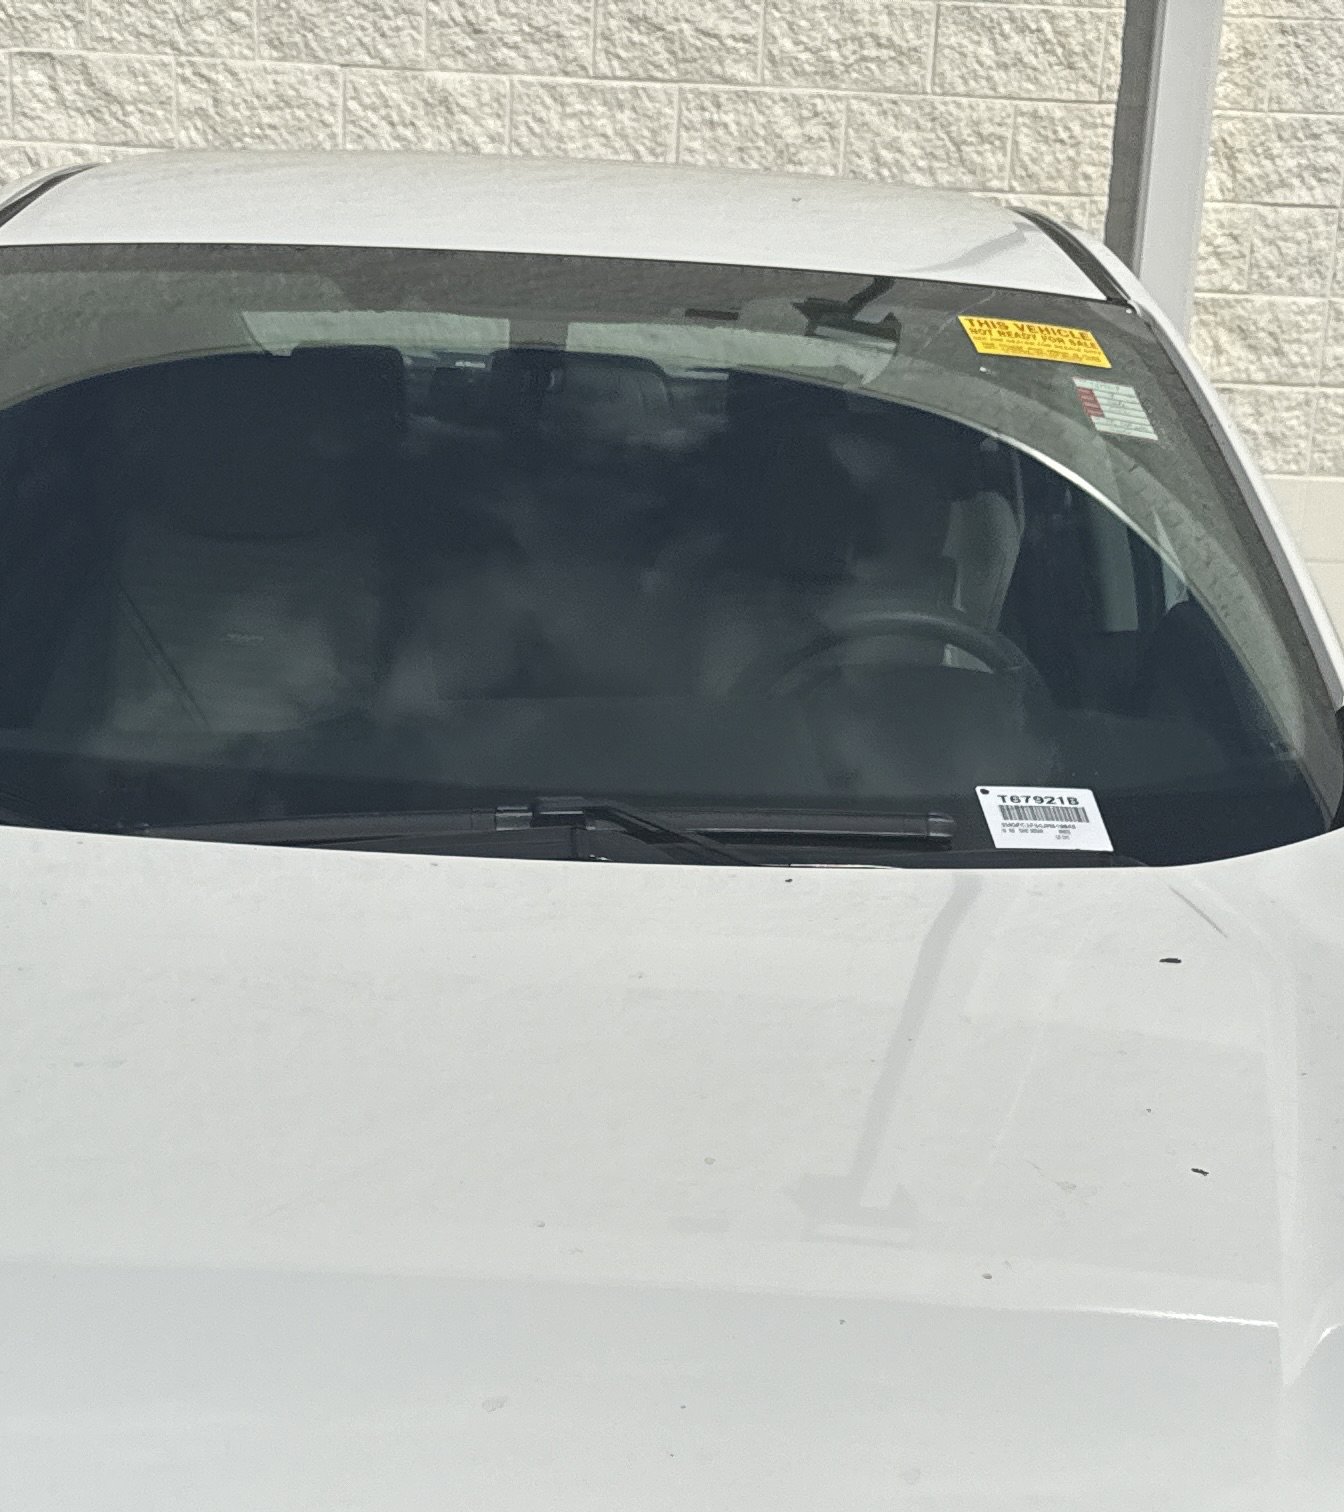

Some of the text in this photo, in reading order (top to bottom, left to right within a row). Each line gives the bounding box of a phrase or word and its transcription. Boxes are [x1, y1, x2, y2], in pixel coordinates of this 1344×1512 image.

[965, 318, 1090, 340] THIS VEHICLE
[969, 327, 994, 337] NOT
[997, 330, 1037, 341] READY
[1041, 333, 1066, 345] FOR
[1068, 338, 1099, 350] SALE
[996, 794, 1080, 806] T67921B
